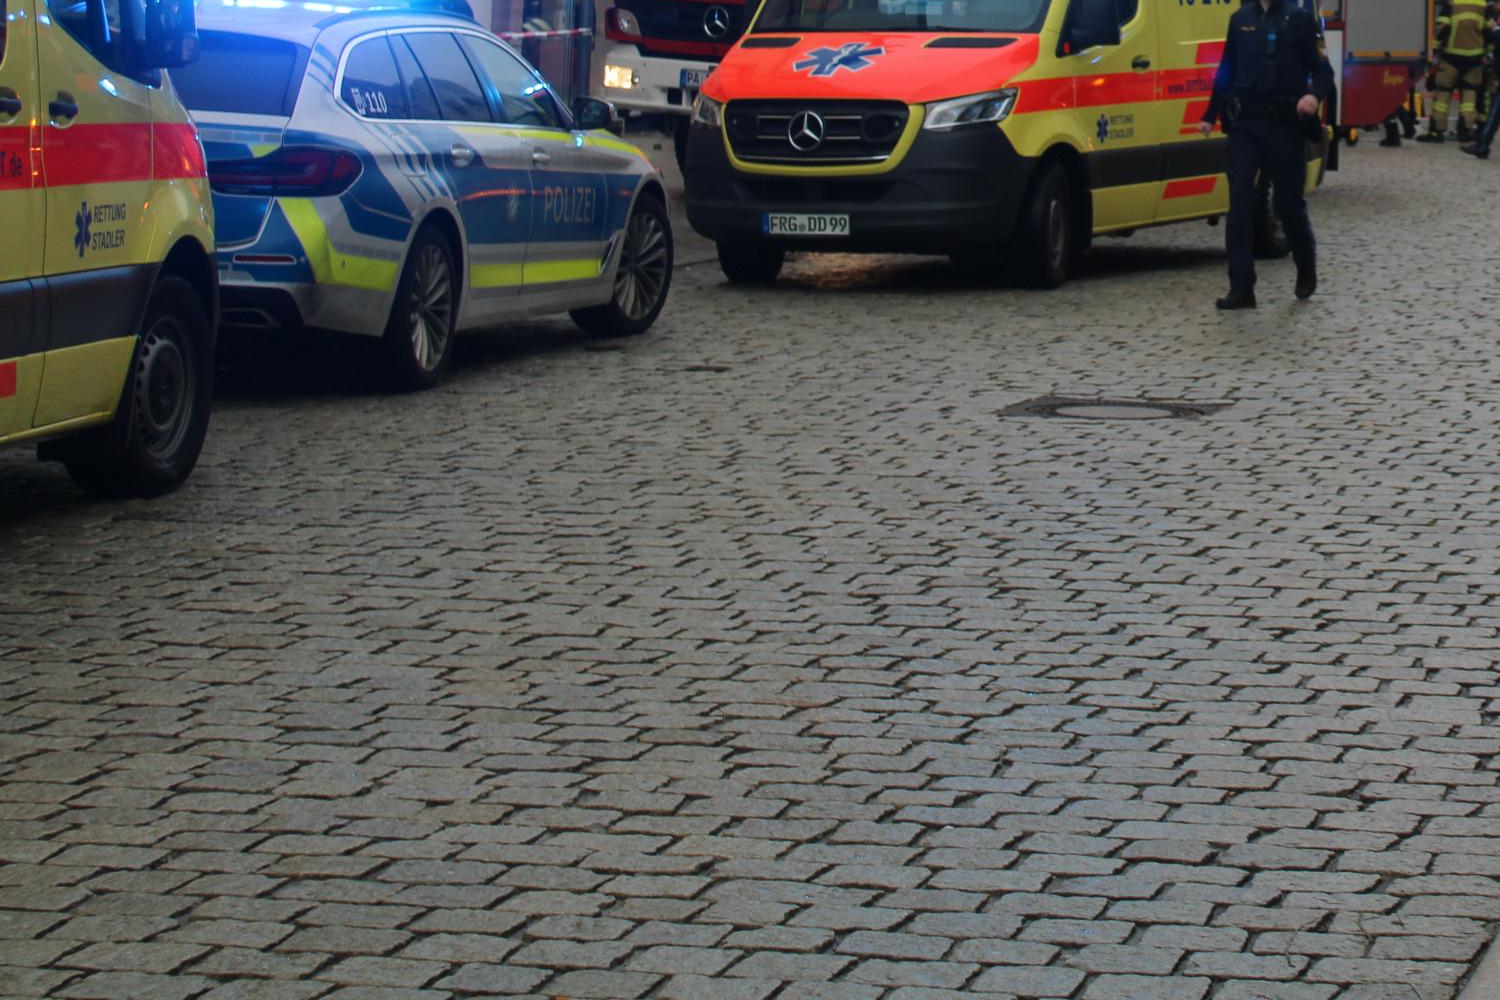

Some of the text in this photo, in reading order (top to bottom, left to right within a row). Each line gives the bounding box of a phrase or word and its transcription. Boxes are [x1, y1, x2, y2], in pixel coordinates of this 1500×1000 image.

[367, 91, 389, 113] 110
[93, 202, 127, 224] RETTUNG
[543, 185, 596, 224] POLIZEI
[770, 216, 847, 233] FRG DD 99
[92, 229, 126, 250] STADLER
